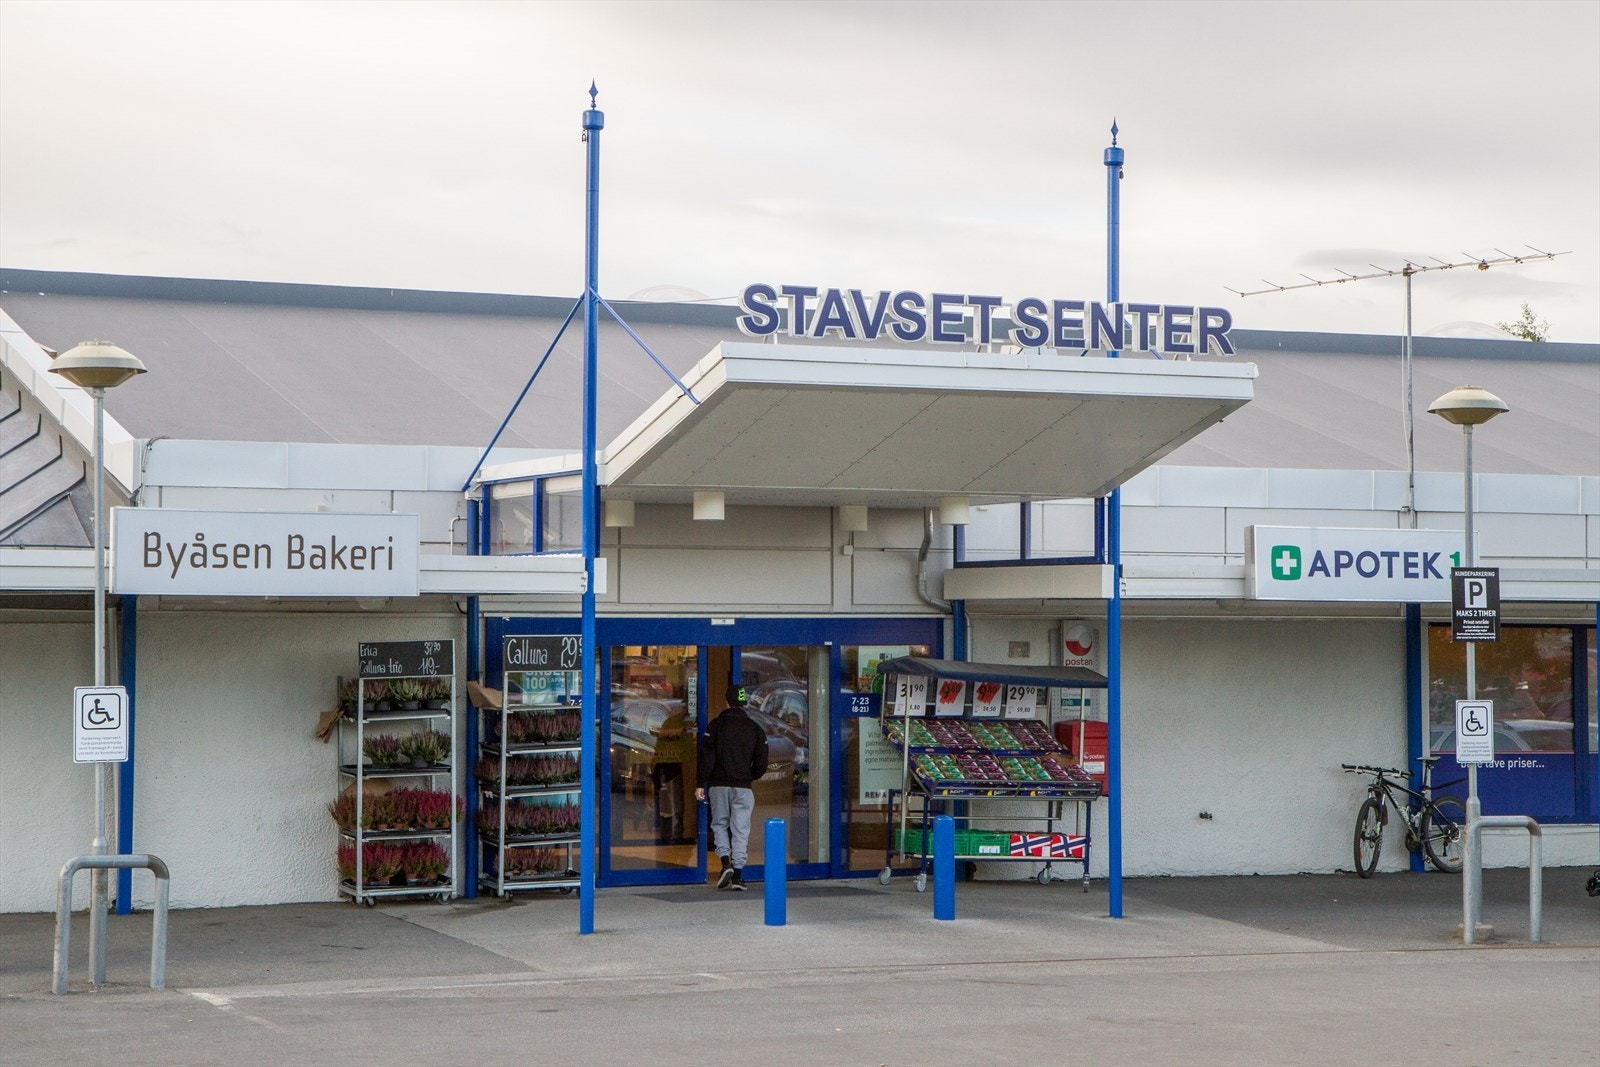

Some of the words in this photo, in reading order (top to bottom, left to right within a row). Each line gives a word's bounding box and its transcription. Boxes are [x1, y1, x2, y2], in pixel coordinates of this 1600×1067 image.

[737, 282, 1002, 345] STAVSET
[1009, 298, 1236, 356] SENTER
[143, 531, 272, 579] Byåsen
[287, 534, 393, 571] Bakeri
[1307, 549, 1443, 578] APOTEK
[1469, 581, 1483, 605] P
[1456, 609, 1473, 617] MAKS
[1473, 609, 1478, 617] 2
[1478, 609, 1496, 617] TIMER
[507, 638, 548, 665] Calluna
[388, 657, 403, 674] trio
[1065, 658, 1093, 666] posten
[526, 677, 547, 690] 100
[851, 697, 870, 705] 7-23
[851, 705, 870, 713] (8-21)
[1507, 757, 1545, 771] priser...
